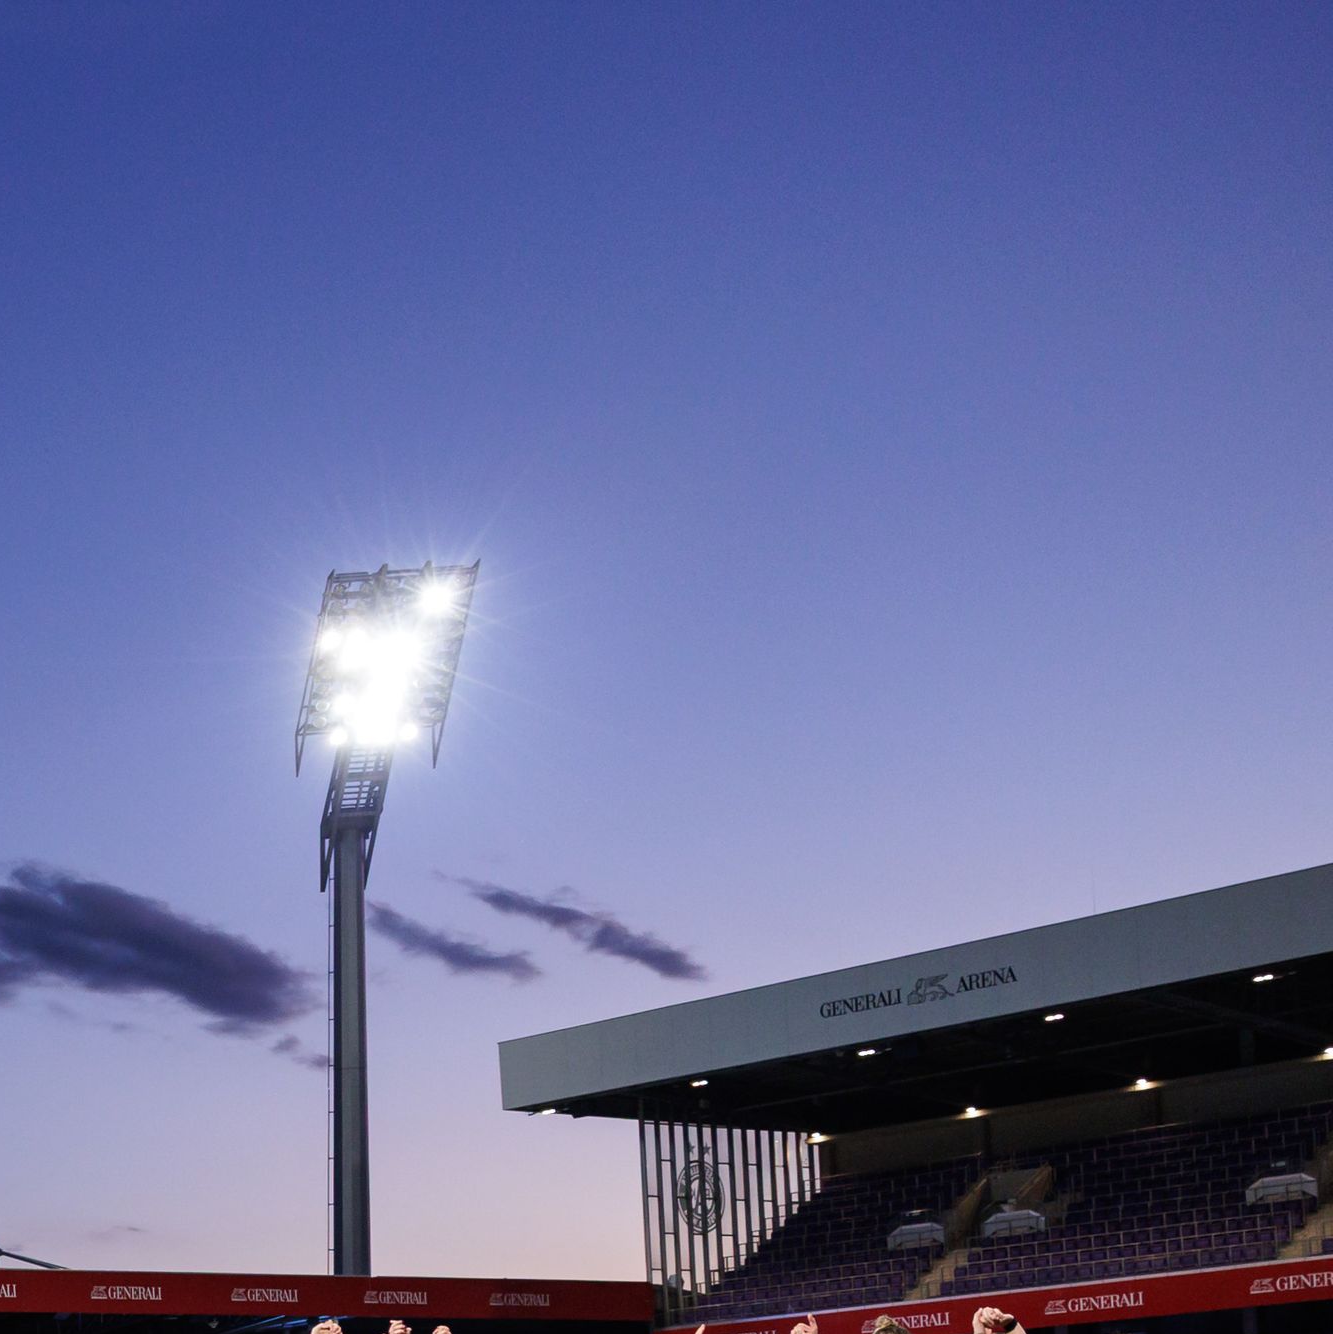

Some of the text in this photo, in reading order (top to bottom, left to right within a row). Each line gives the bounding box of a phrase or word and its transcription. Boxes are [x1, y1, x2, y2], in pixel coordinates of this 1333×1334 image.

[820, 966, 1018, 1018] GENERALI ARENA
[108, 1286, 163, 1300] GENERALI
[247, 1288, 299, 1303] GENERALI
[378, 1291, 428, 1305] GENERALI
[503, 1293, 550, 1307] GENERALI
[1067, 1291, 1145, 1313] GENERALI
